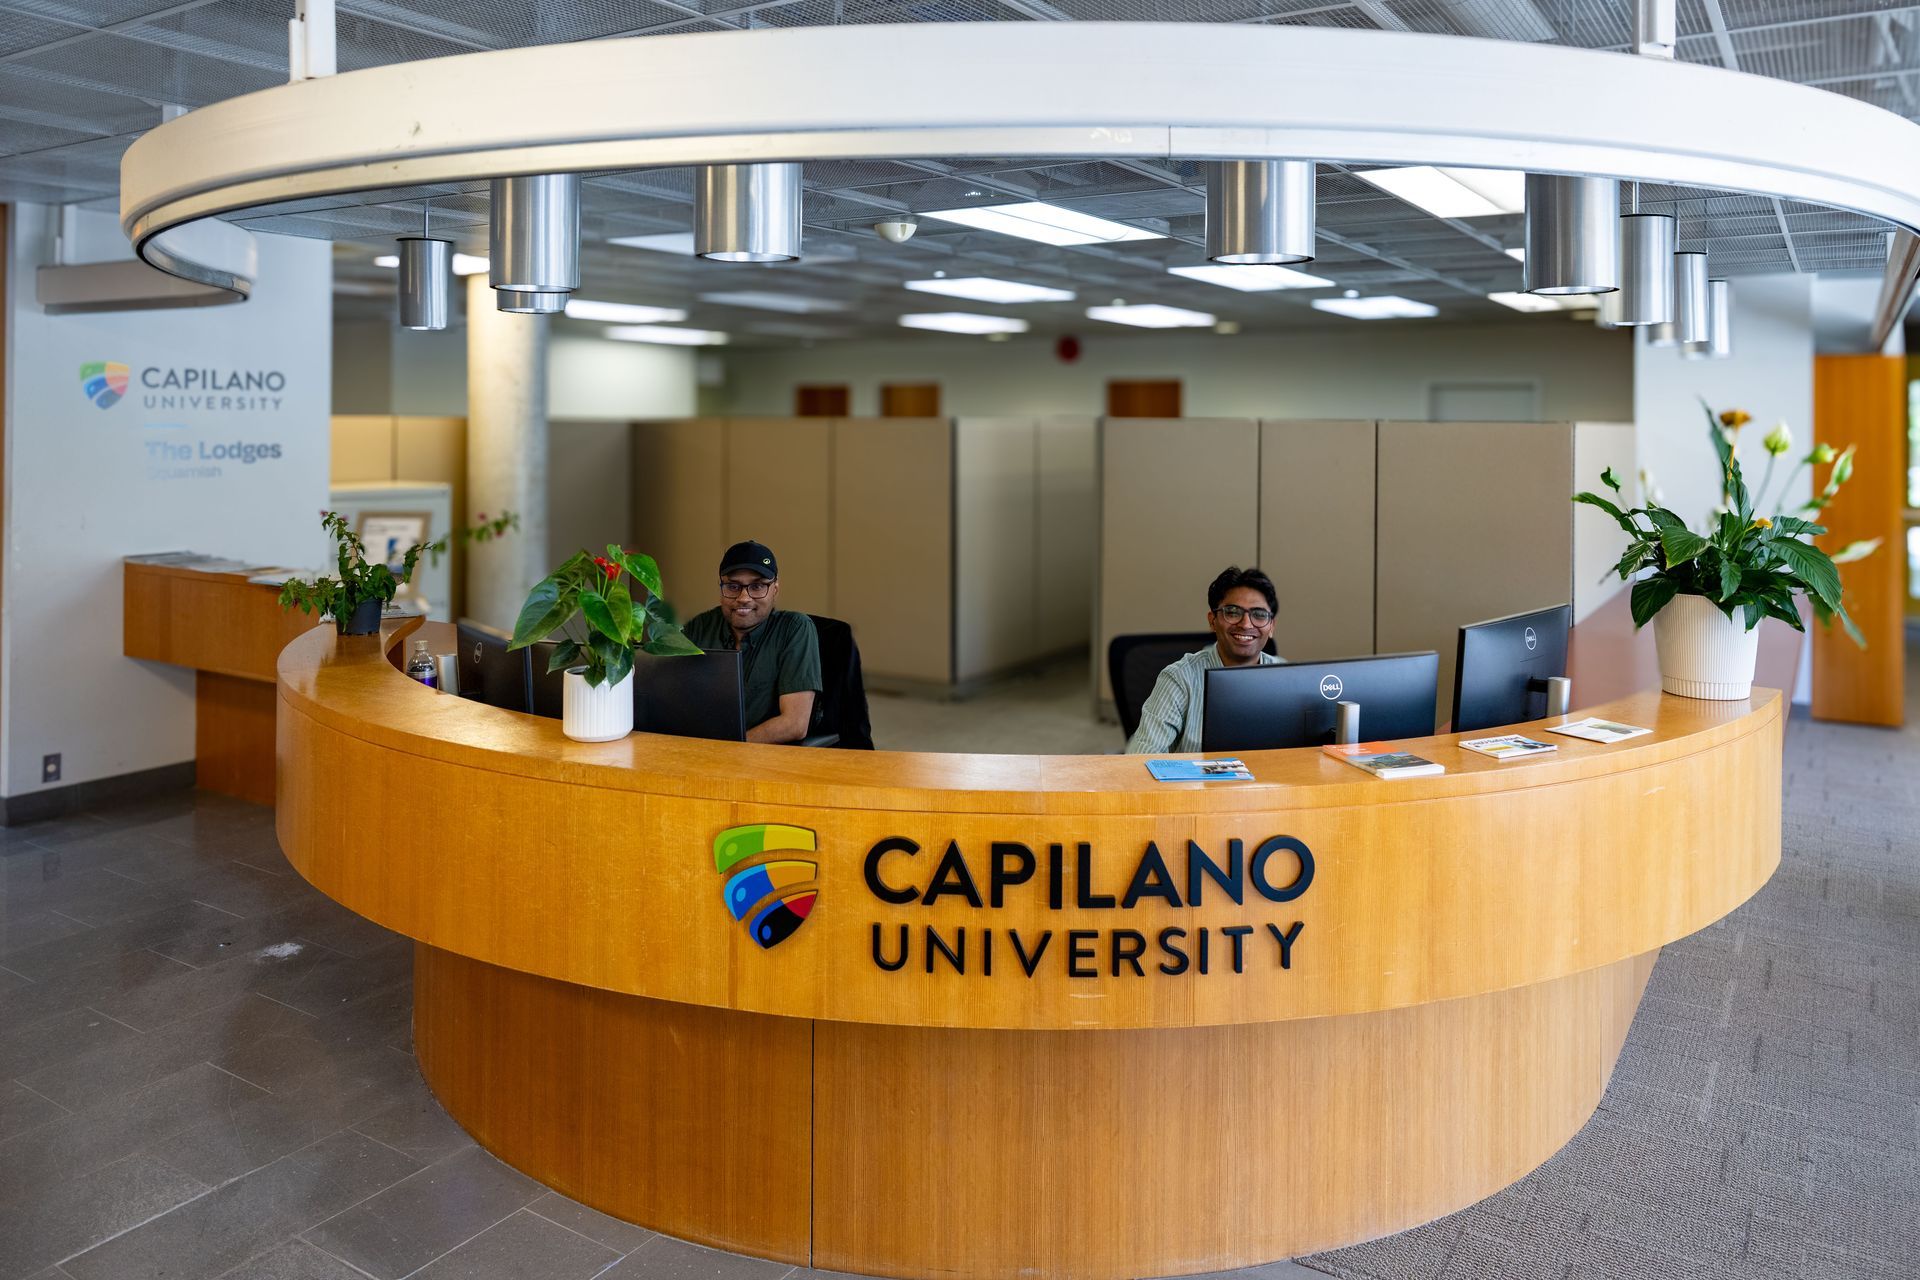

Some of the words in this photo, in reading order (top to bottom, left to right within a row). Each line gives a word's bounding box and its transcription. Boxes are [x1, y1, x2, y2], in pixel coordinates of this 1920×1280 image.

[141, 367, 286, 392] CAPILANO
[143, 395, 283, 411] UNIVERSITY
[144, 440, 193, 460] The
[198, 439, 283, 464] Lodges
[1322, 683, 1341, 691] DELL
[863, 834, 1316, 910] CAPILANO
[872, 920, 1305, 979] UNIVERSITY
